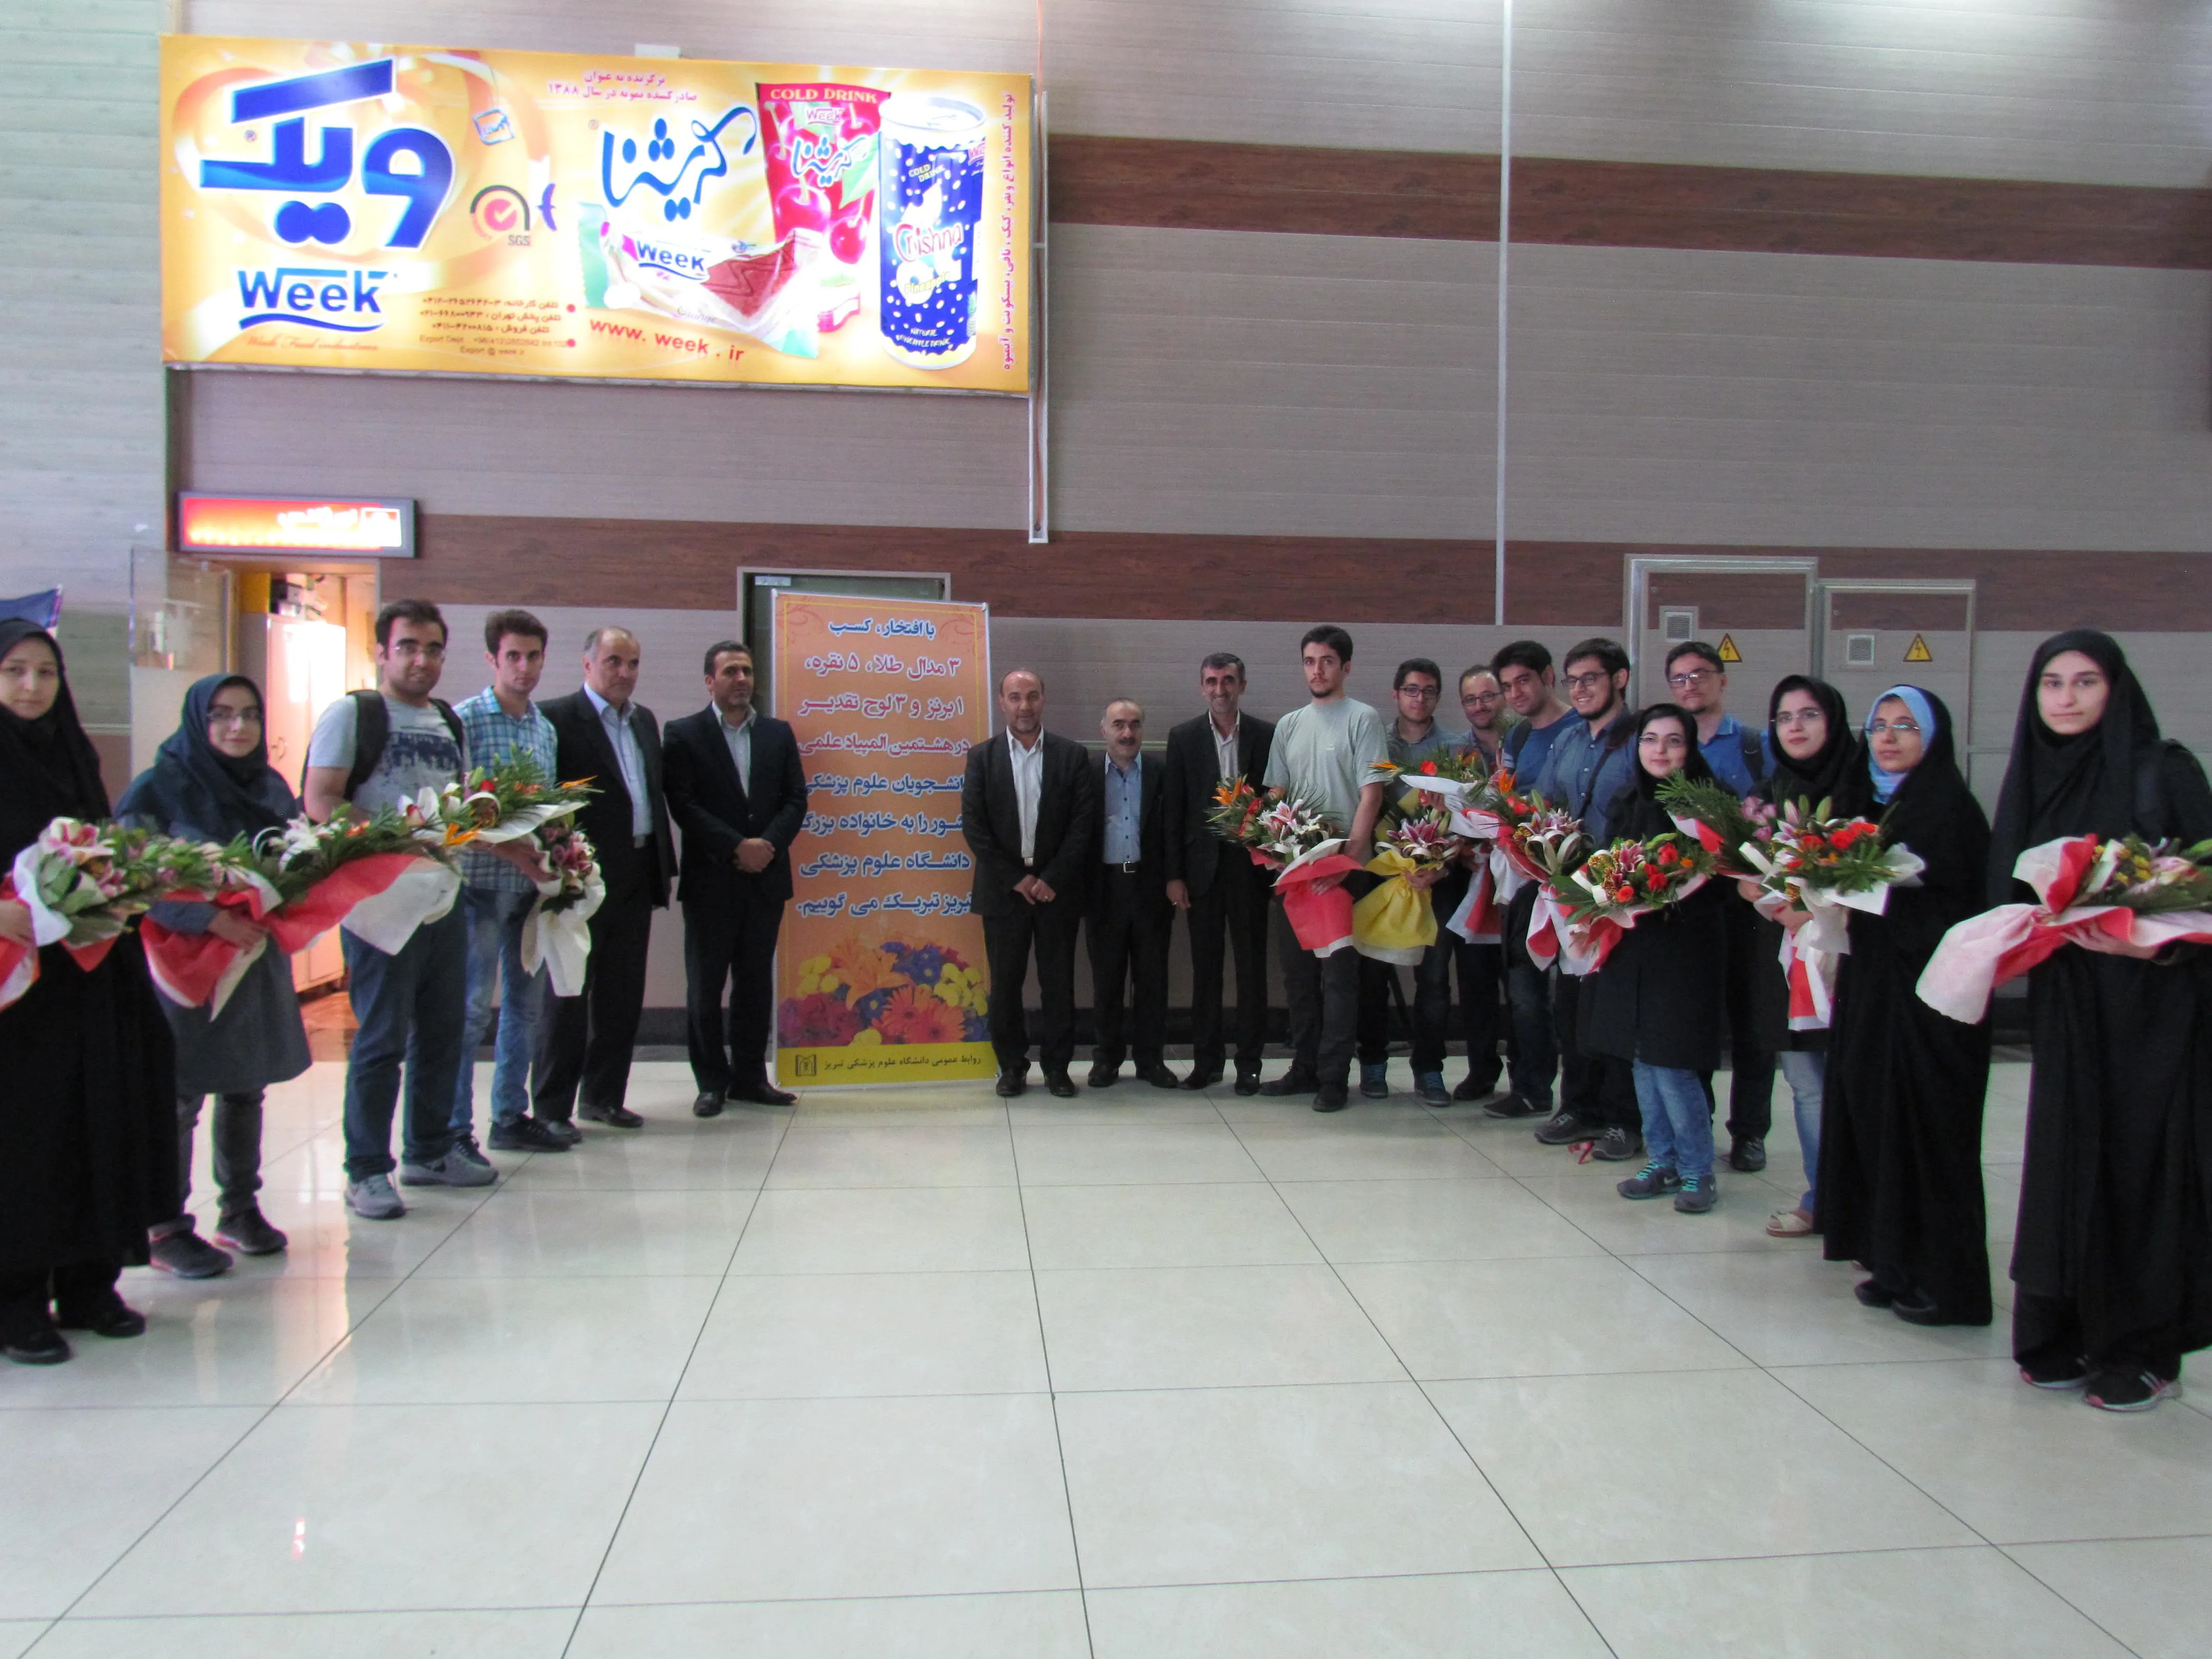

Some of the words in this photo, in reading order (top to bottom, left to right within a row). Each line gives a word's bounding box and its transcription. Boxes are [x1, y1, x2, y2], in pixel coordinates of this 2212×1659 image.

[584, 71, 612, 83] عنوان
[615, 74, 624, 82] به
[548, 83, 580, 95] ۱۳۸۸
[582, 85, 603, 98] سال
[605, 89, 616, 100] در
[619, 90, 643, 101] نمونه
[770, 88, 818, 100] COLD
[824, 88, 877, 103] DRINK
[806, 108, 845, 122] Week
[1002, 94, 1015, 120] تولید
[1001, 123, 1012, 153] کننده
[200, 59, 454, 248] ویک
[908, 164, 931, 177] COLD
[918, 164, 946, 182] DRINK
[1001, 155, 1014, 182] انواع
[508, 234, 531, 246] SGS
[896, 223, 962, 262] Crishna
[637, 239, 711, 272] Week
[238, 267, 389, 313] Week
[830, 618, 873, 636] کسب
[925, 620, 936, 640] با
[847, 653, 859, 671] ۵
[907, 657, 946, 679] مدال
[949, 657, 961, 676] ۳
[797, 692, 860, 716] تقدیر
[862, 694, 892, 718] لوح
[895, 694, 907, 712] ۳
[910, 700, 921, 717] و
[924, 697, 954, 719] برنز
[798, 732, 844, 754] علمی
[888, 736, 953, 757] هشتمین
[953, 739, 971, 755] در
[852, 773, 889, 796] علوم
[892, 773, 965, 797] انشجویان
[839, 812, 898, 837] خانواده
[900, 814, 915, 833] به
[918, 812, 929, 834] را
[799, 852, 859, 877] پزشکی
[862, 851, 902, 876] علوم
[905, 851, 971, 870] دانشگاه
[849, 897, 879, 917] می
[824, 1060, 844, 1070] تبریز
[846, 1058, 875, 1069] پزشکی
[878, 1057, 896, 1068] علوم
[899, 1056, 930, 1065] دانشگاه
[932, 1056, 958, 1067] عمومی
[961, 1054, 981, 1065] روابط
